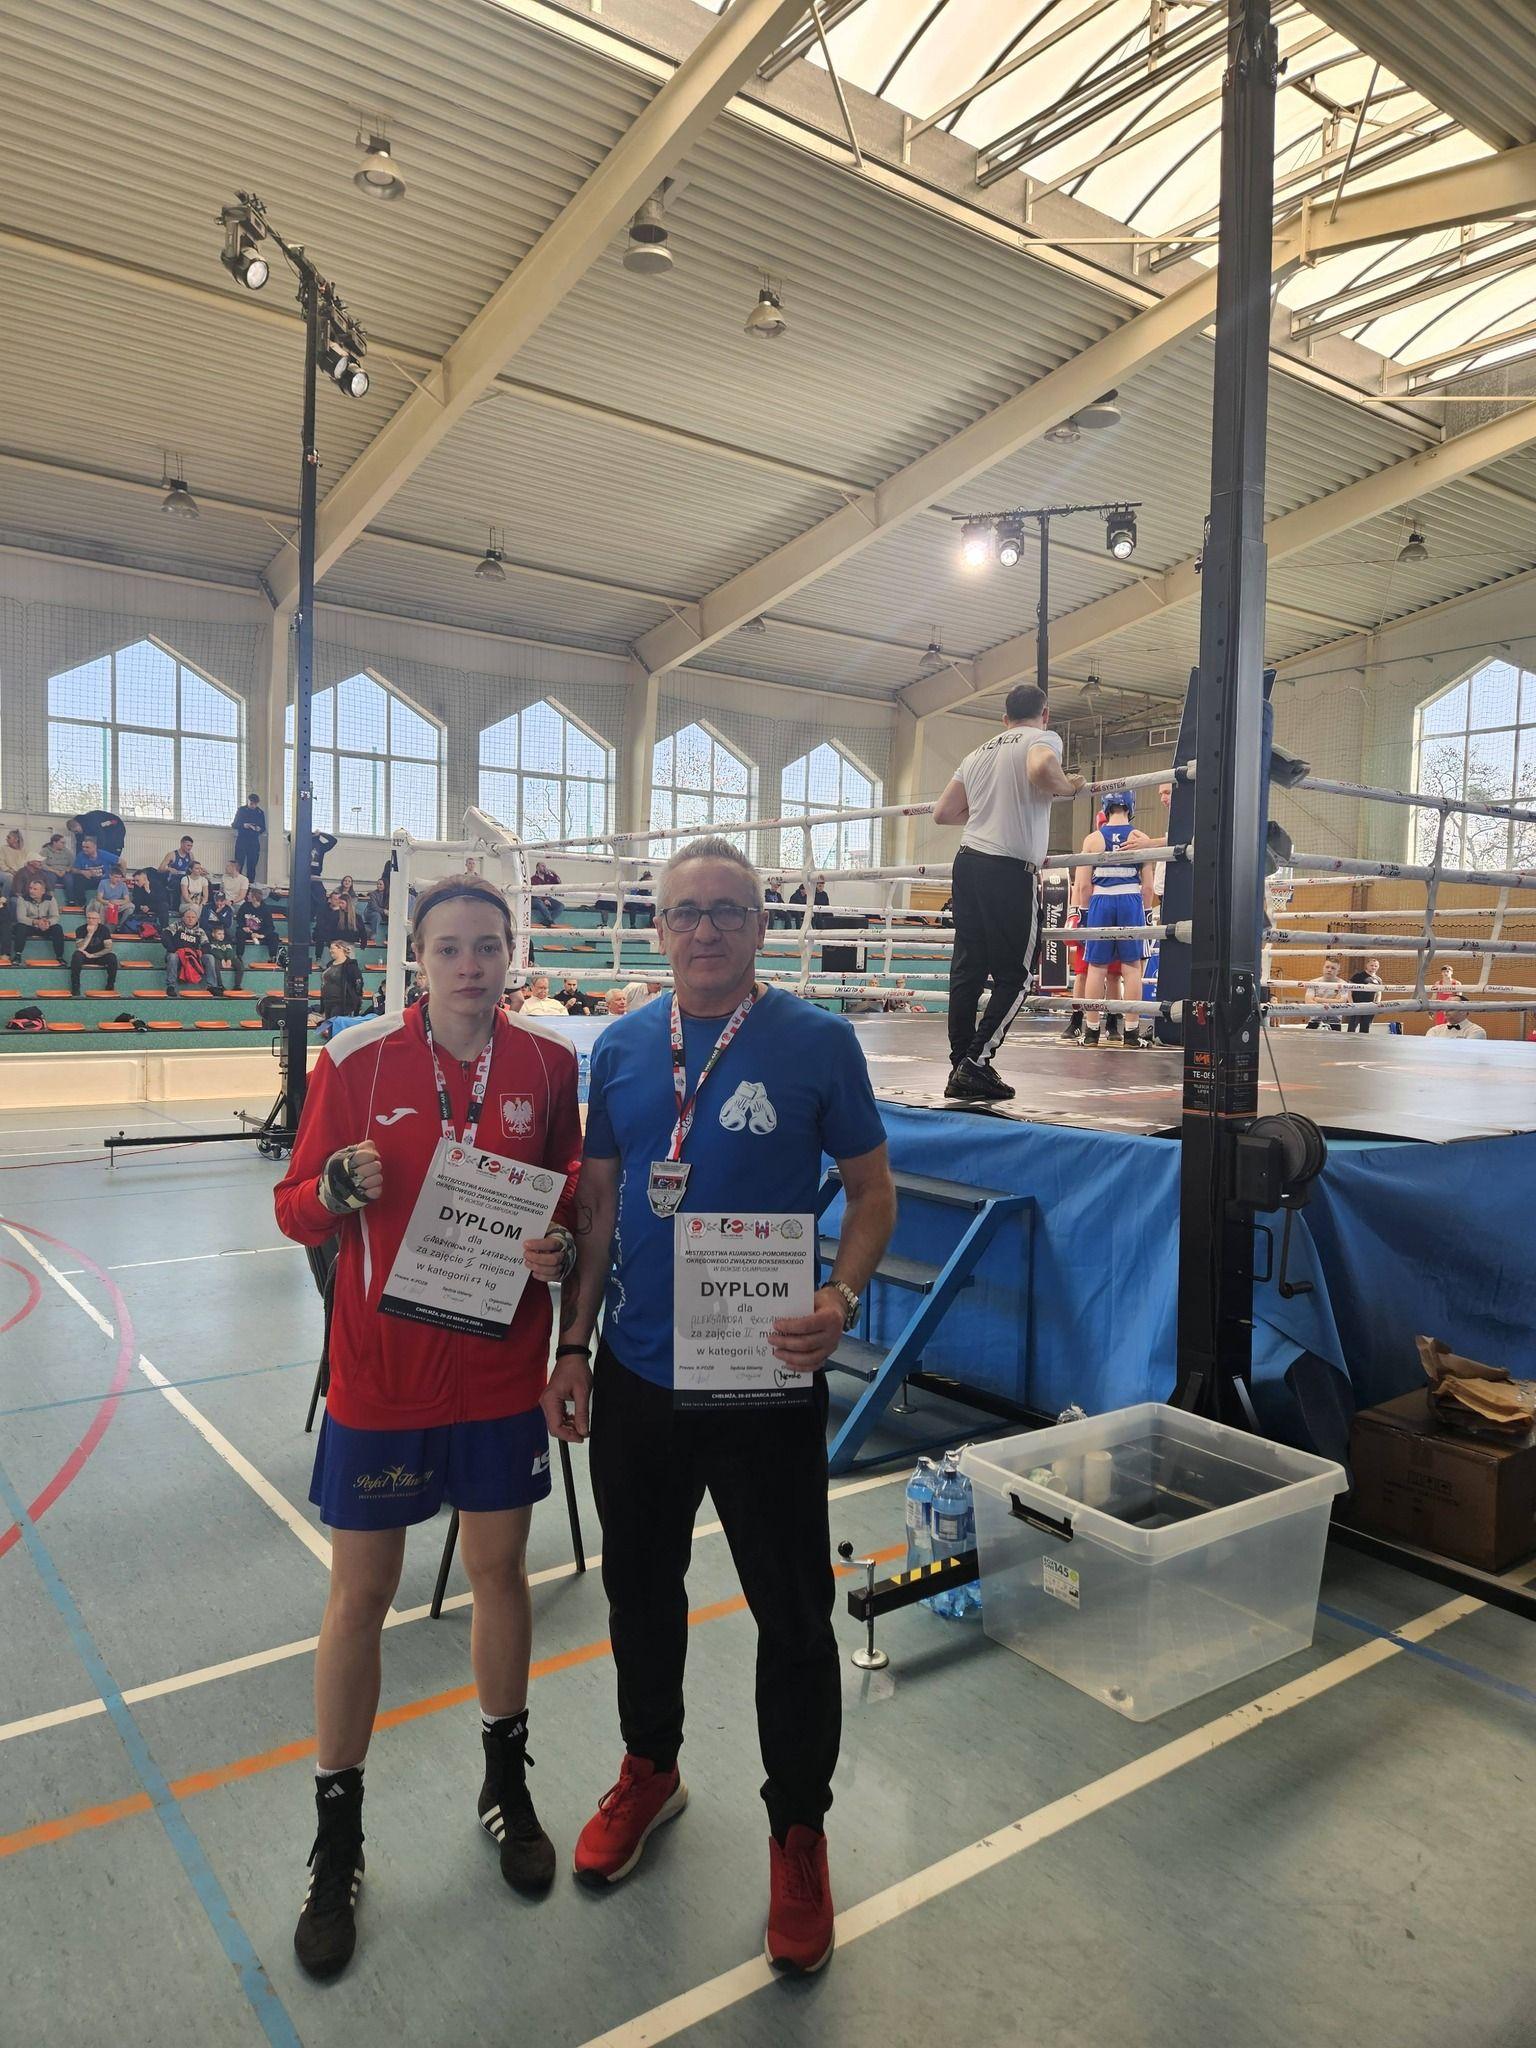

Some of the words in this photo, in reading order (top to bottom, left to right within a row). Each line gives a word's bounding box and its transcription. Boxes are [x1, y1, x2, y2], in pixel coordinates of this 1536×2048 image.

[501, 1200, 544, 1216] BOKSERSKIEGO
[439, 1205, 522, 1240] DYPLOM
[467, 1234, 482, 1245] dla
[416, 1246, 427, 1255] za
[430, 1249, 464, 1264] zajęcie
[479, 1262, 515, 1277] miejsca
[416, 1262, 426, 1271] w
[427, 1264, 470, 1282] kategorii
[485, 1279, 497, 1290] kg
[701, 1281, 789, 1298] DYPLOM
[737, 1303, 753, 1313] dla
[690, 1330, 702, 1338] za
[705, 1328, 742, 1340] zajęcie
[696, 1348, 705, 1356] w
[708, 1346, 754, 1358] kategorii
[1053, 1561, 1069, 1578] 145
